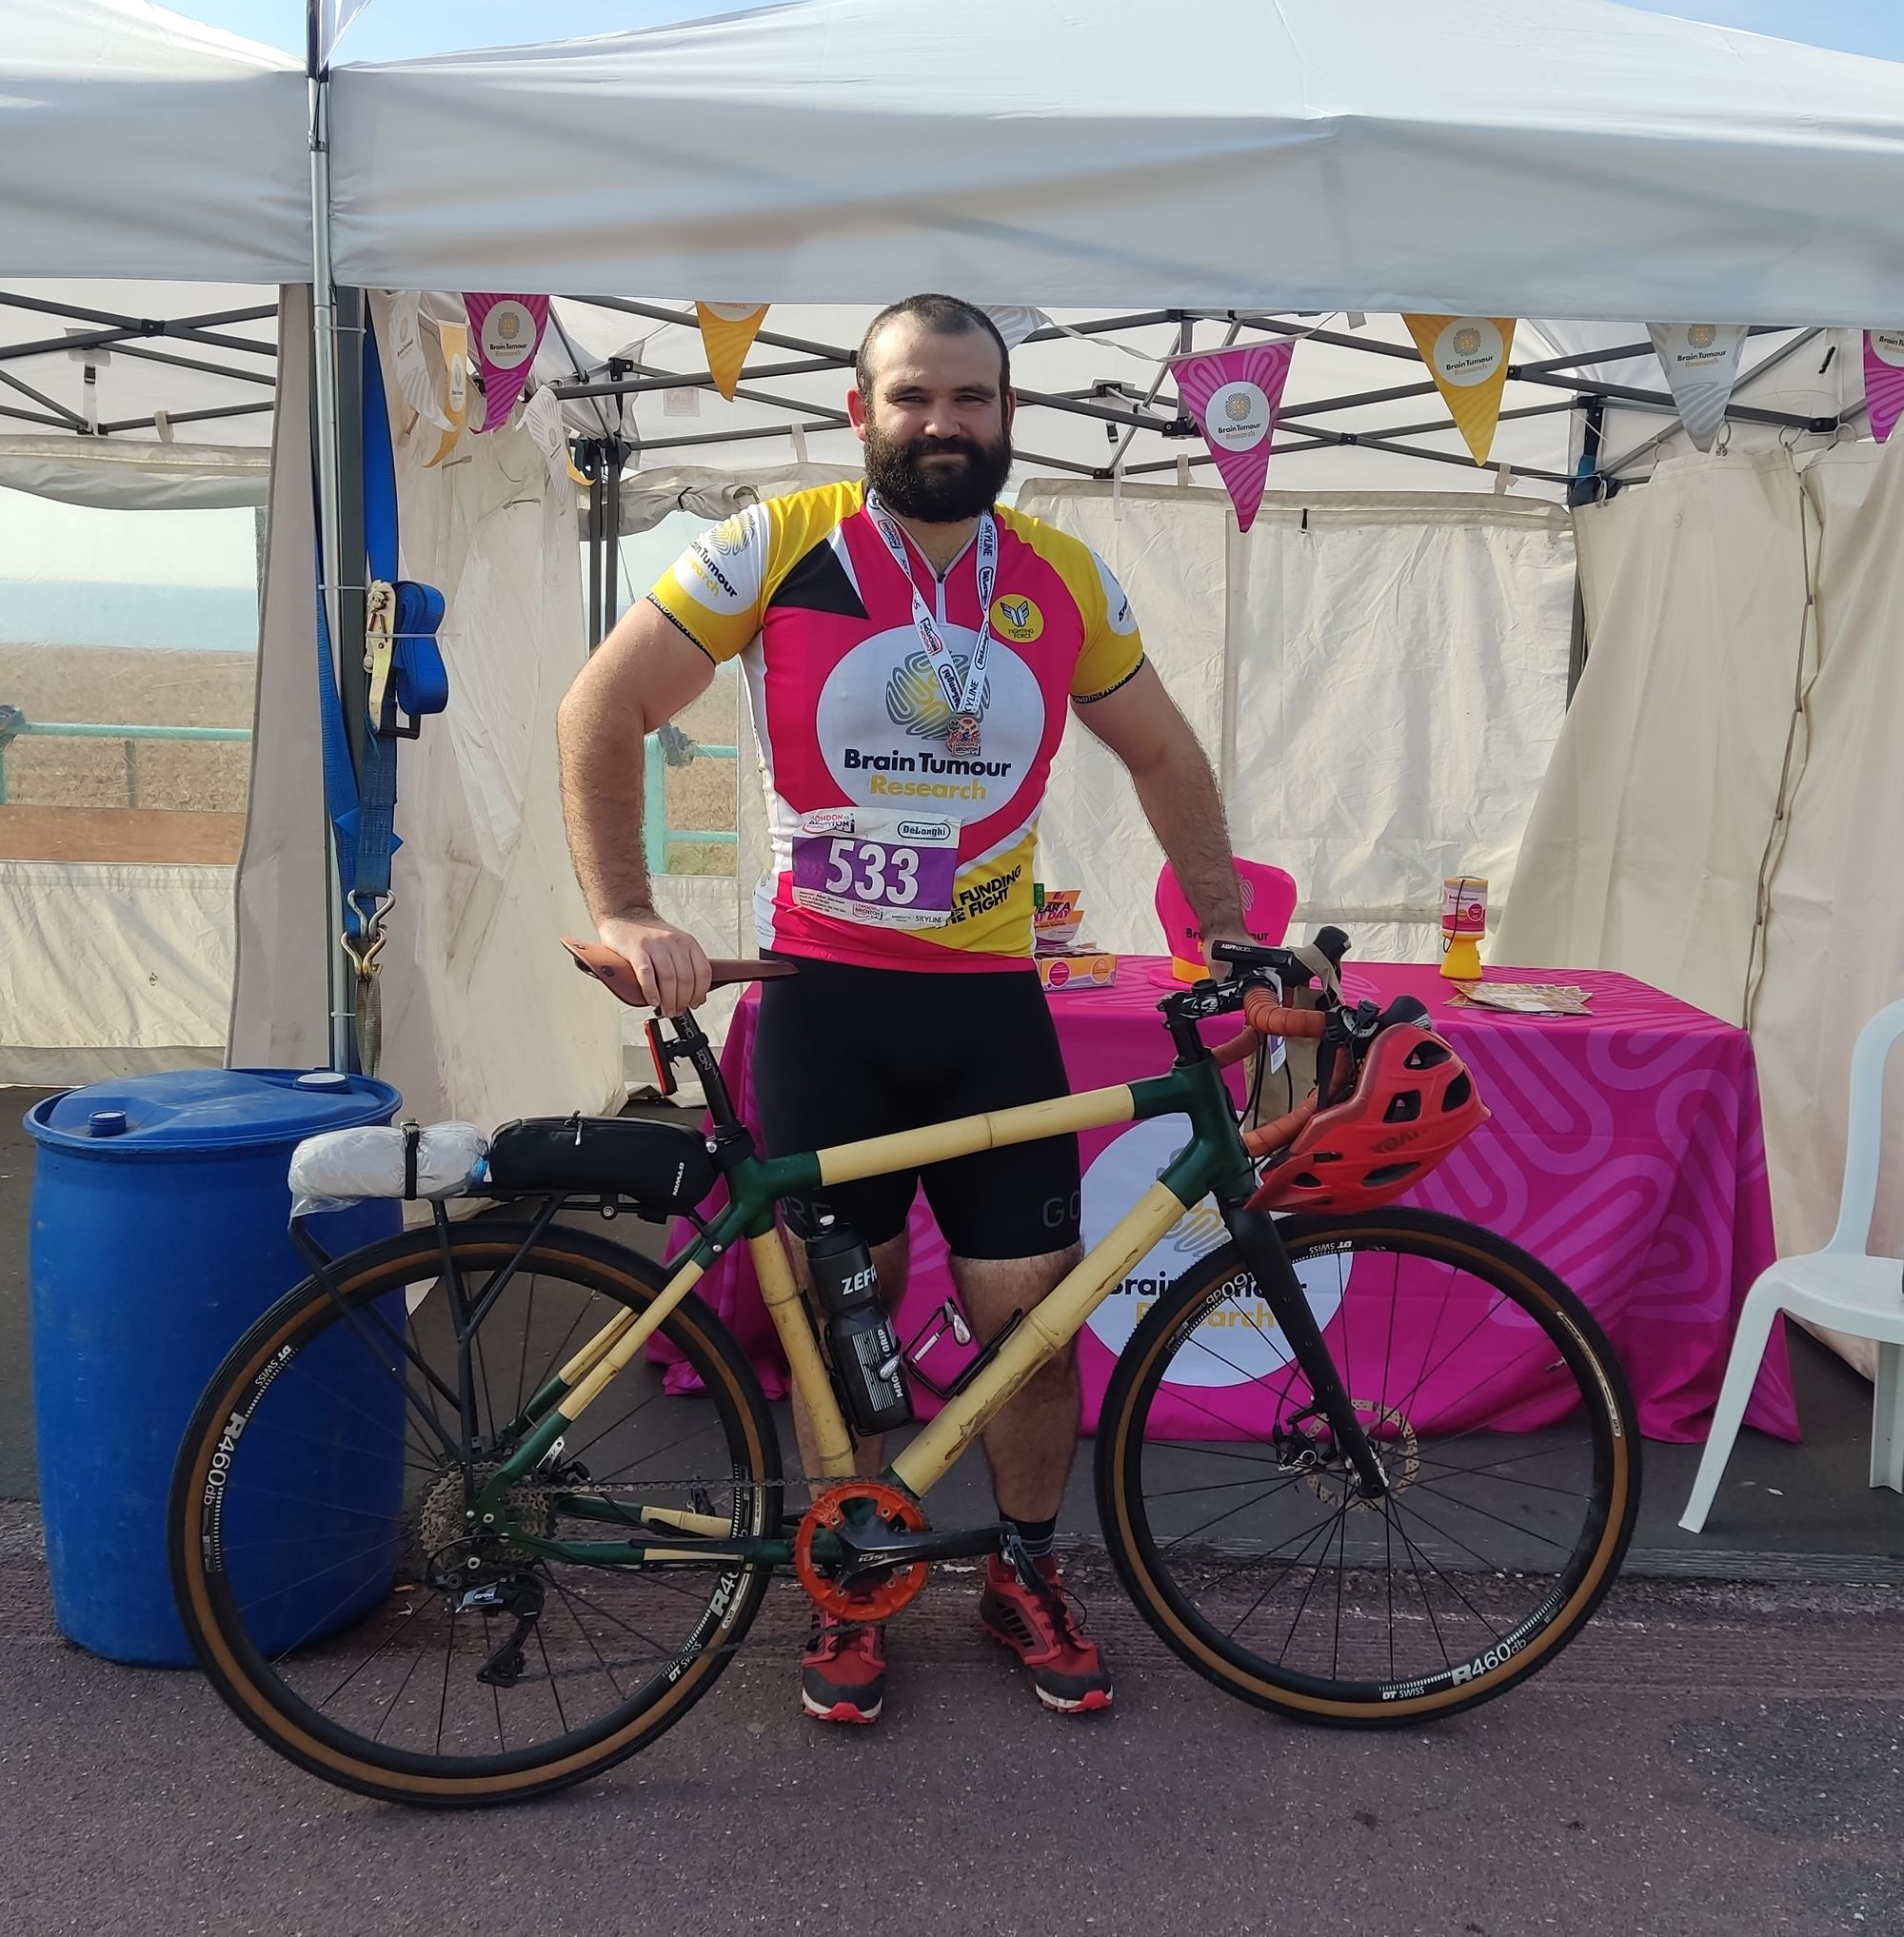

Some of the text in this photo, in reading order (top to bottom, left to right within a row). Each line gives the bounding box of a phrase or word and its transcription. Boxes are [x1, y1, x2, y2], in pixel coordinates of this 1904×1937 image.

[1879, 335, 1898, 345] Brain
[1446, 355, 1494, 370] Brain Tumour
[1677, 350, 1727, 362] Brain Tumour
[1219, 425, 1236, 433] Brain
[983, 523, 993, 557] SKYLINE
[700, 547, 738, 598] Tumour
[963, 679, 980, 713] KYLINE
[844, 748, 1011, 777] Brain Tumour
[870, 775, 986, 800] Research
[902, 825, 946, 837] DeLonghi
[824, 838, 920, 904] 533
[959, 864, 1021, 906] FUNDING
[968, 886, 1009, 918] FIGHT
[915, 915, 942, 923] SKYLINE
[1309, 1240, 1353, 1255] DT SWISS
[841, 1263, 878, 1295] ZEFA
[277, 1344, 292, 1362] DT
[878, 1329, 890, 1354] GRIP
[254, 1358, 279, 1387] SWISS
[668, 1665, 683, 1683] DT
[1382, 1639, 1527, 1700] DT SWISS R460db
